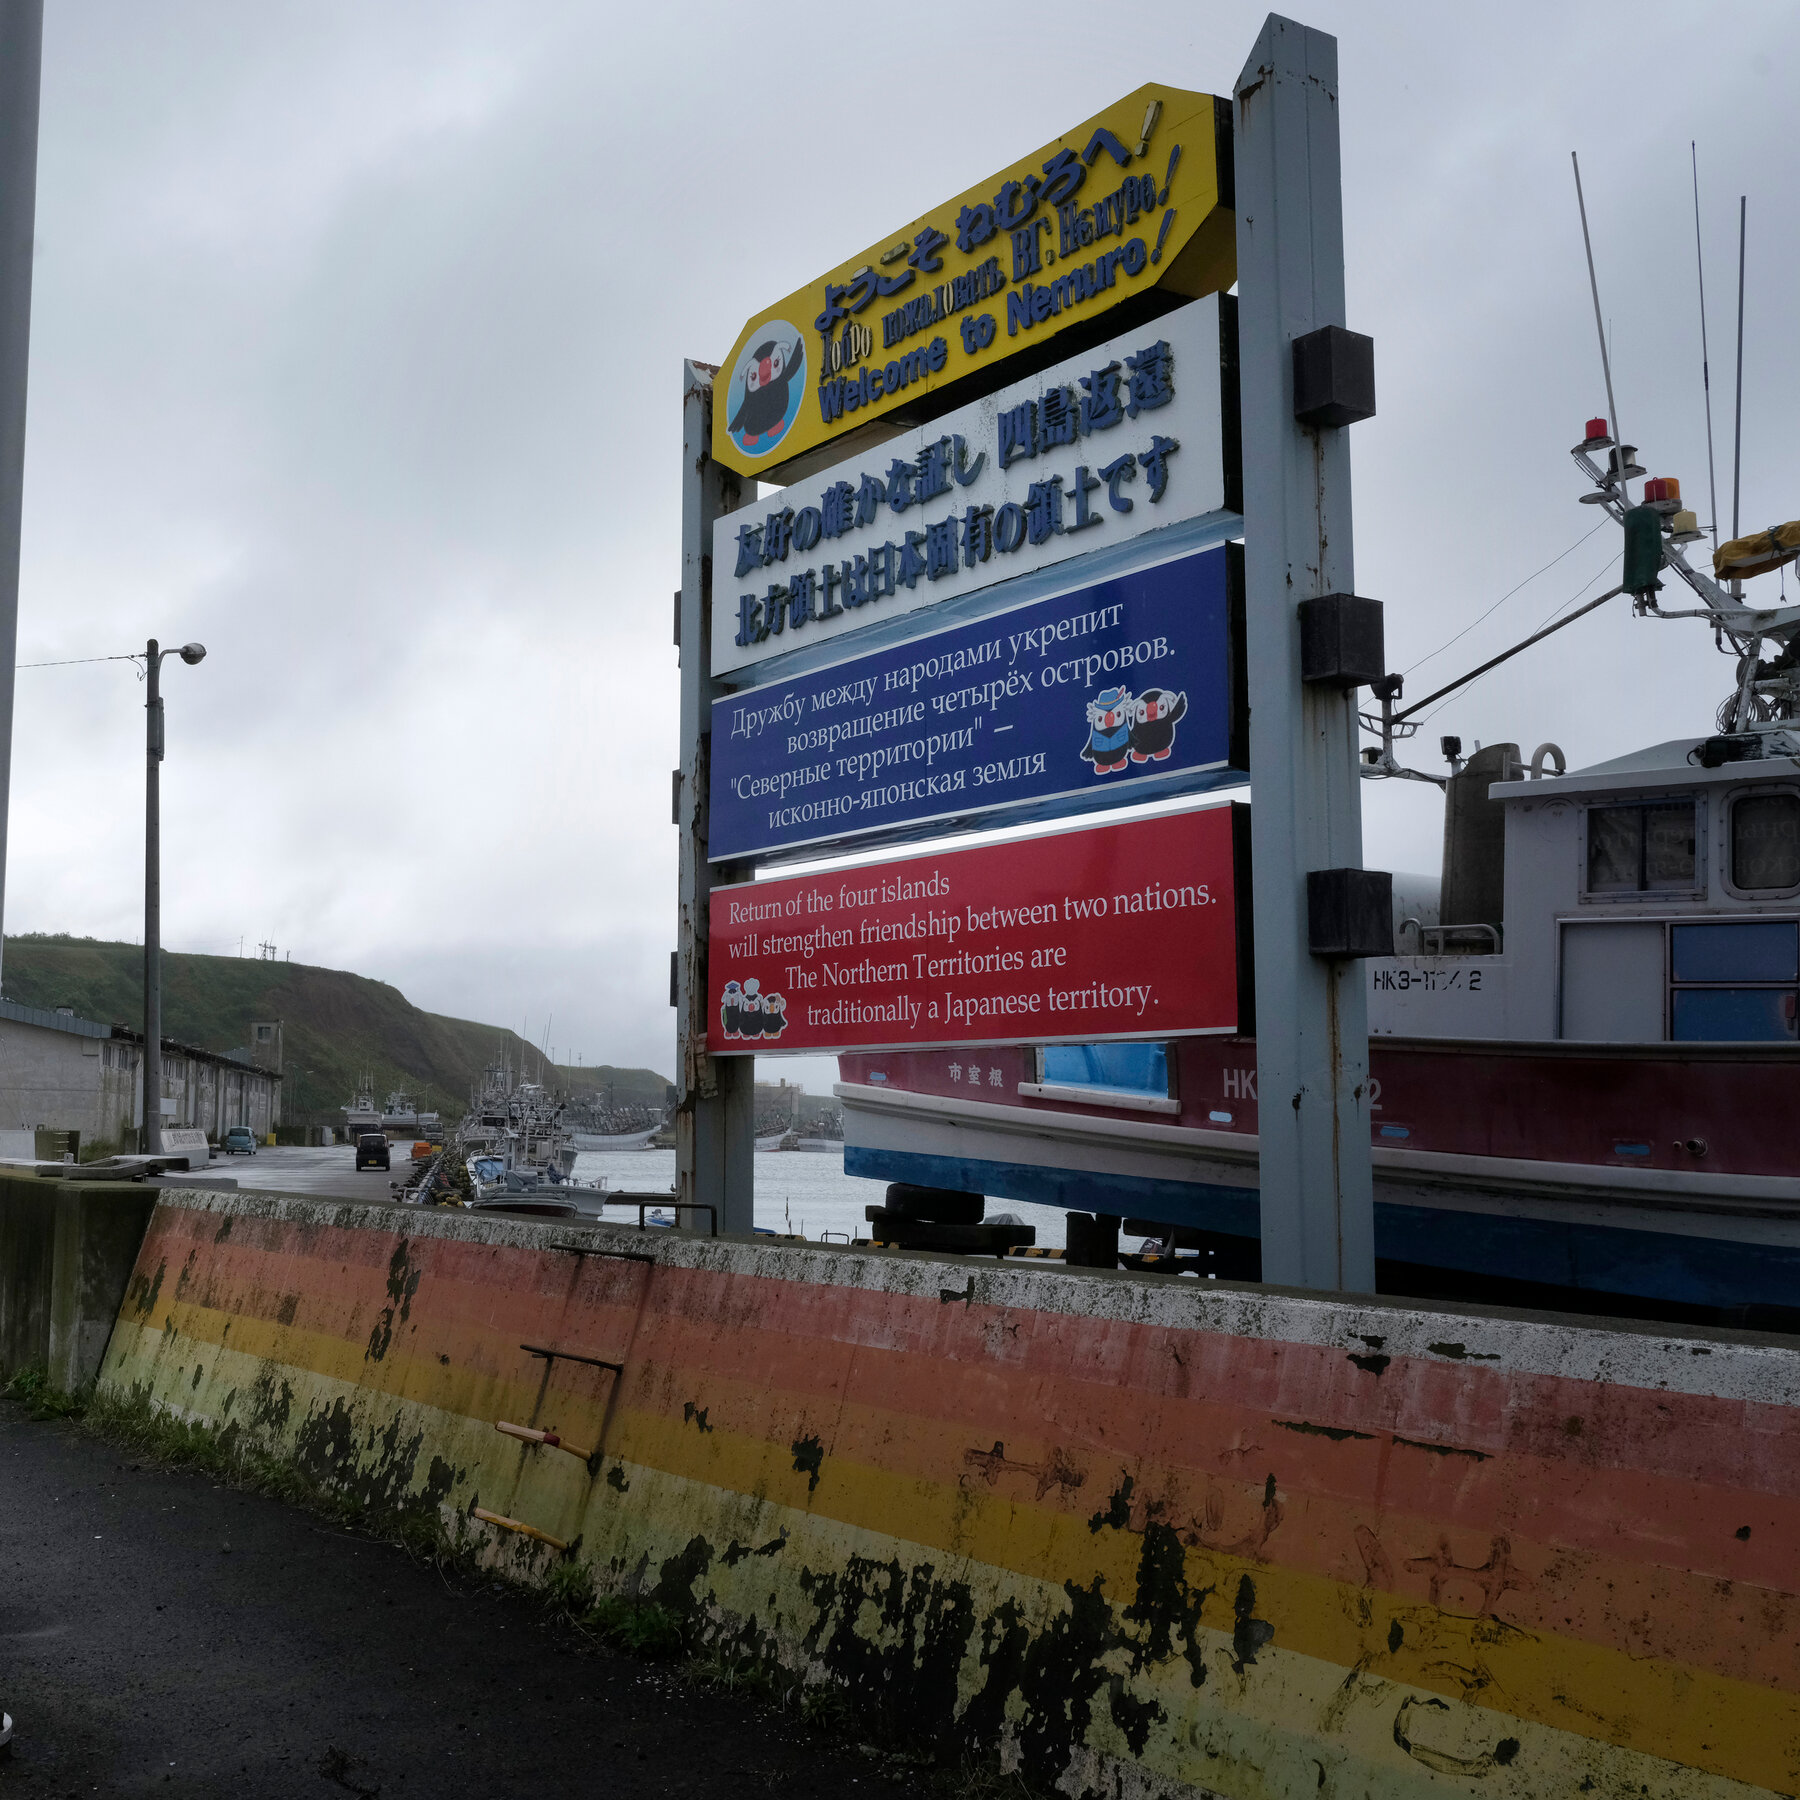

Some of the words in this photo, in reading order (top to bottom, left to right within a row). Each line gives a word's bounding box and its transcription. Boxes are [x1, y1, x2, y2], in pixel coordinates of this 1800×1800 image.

[815, 226, 949, 332] ようこそ
[818, 336, 948, 423] Welcome
[960, 313, 996, 354] to
[1007, 208, 1177, 336] Nemuro!
[998, 339, 1176, 469] 四島返還
[735, 435, 1180, 646] 北方領土は日本固有の領土です
[731, 692, 805, 739] Дружбу
[812, 677, 878, 711] между
[884, 639, 1002, 693] народами
[1008, 604, 1126, 665] укрепит
[787, 700, 925, 754] возвращение
[931, 666, 1033, 714] четырёх
[1041, 637, 1175, 687] островов.
[731, 764, 832, 802] "Северные
[836, 716, 981, 781] территории"
[769, 776, 966, 830] исконно-японская
[973, 753, 1046, 786] земля
[729, 902, 782, 924] Return
[786, 891, 803, 916] of
[807, 889, 833, 913] the
[839, 884, 877, 909] four
[881, 870, 949, 903] islands
[729, 934, 758, 958] will
[763, 925, 853, 958] strengthen
[860, 910, 960, 944] friendship
[966, 904, 1057, 931] between
[1064, 897, 1107, 920] two
[1113, 882, 1216, 914] nations.
[785, 966, 818, 990] The
[823, 959, 908, 986] Northern
[913, 946, 1023, 978] Territories
[1031, 947, 1066, 968] are
[808, 995, 922, 1029] traditionally
[928, 1001, 939, 1018] a
[945, 992, 1040, 1025] Japanese
[1048, 981, 1158, 1016] territory.
